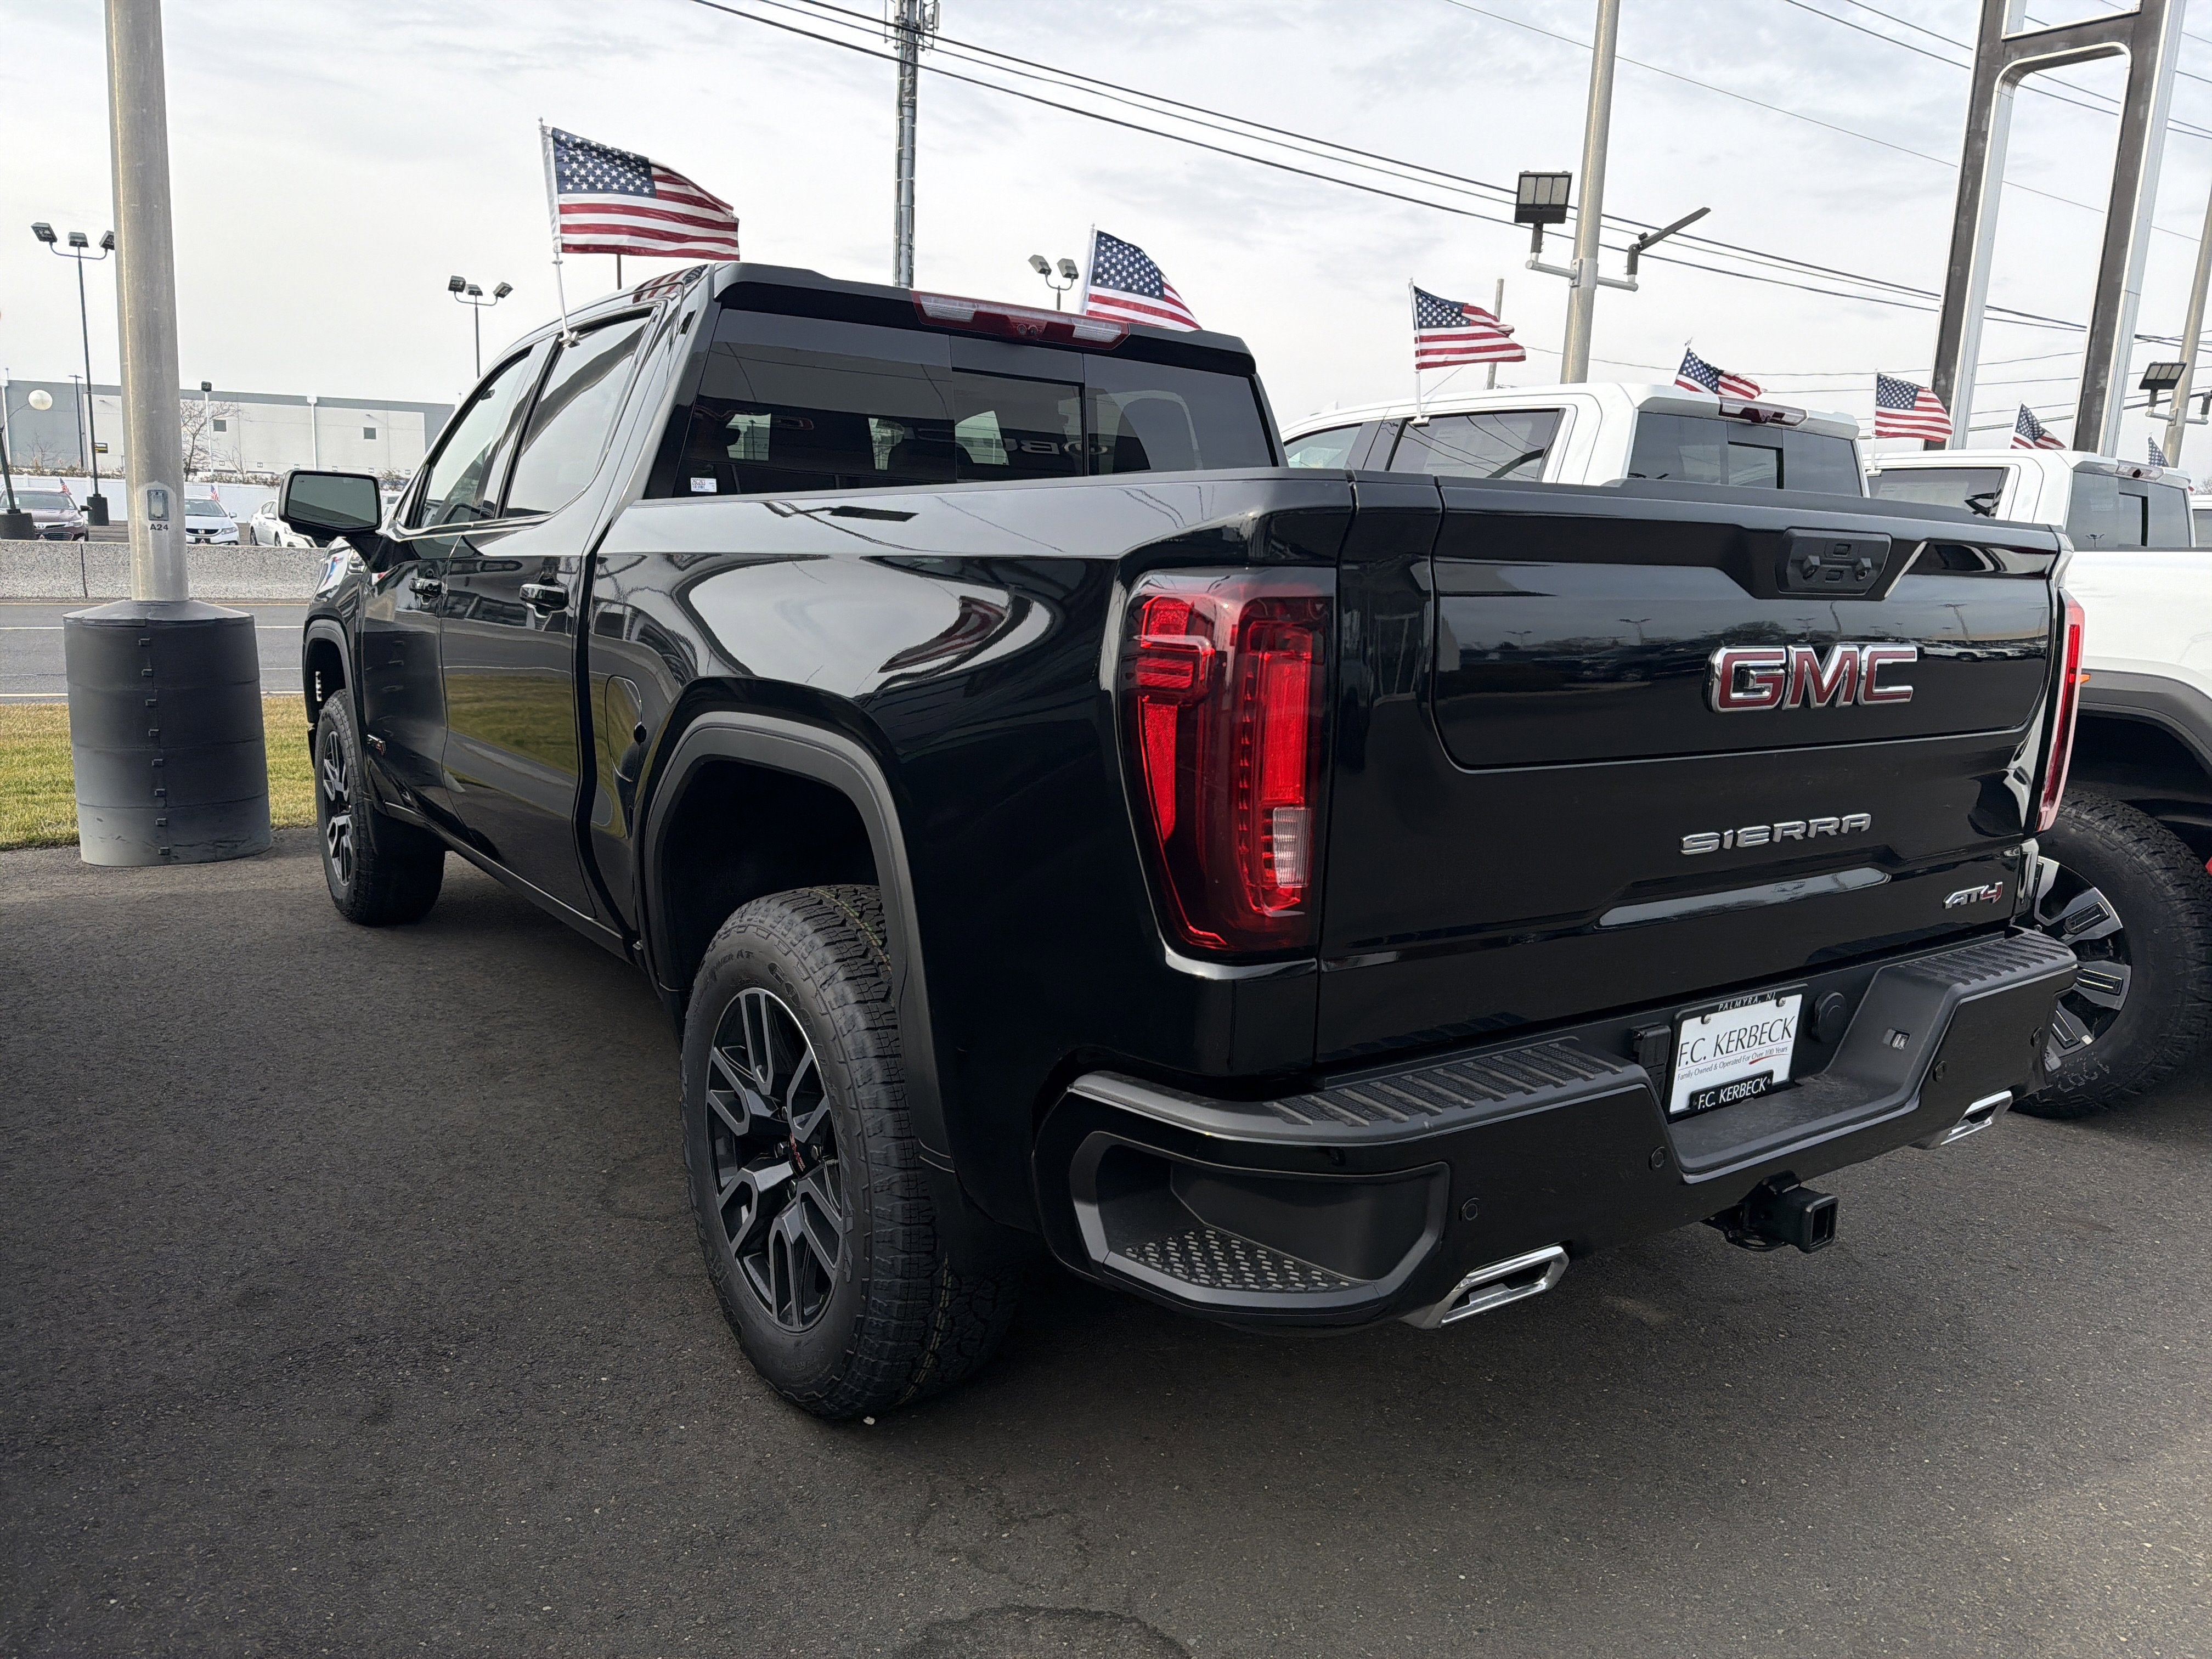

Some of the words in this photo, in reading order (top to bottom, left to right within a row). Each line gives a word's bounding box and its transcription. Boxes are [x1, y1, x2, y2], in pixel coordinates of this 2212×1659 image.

[1707, 644, 1918, 713] GMC
[1680, 812, 1872, 855] SIERRA
[1943, 881, 2003, 910] AT4
[1718, 996, 1761, 1012] PALMYRA,
[1678, 1037, 1706, 1068] F.C.
[1713, 1015, 1796, 1058] KERBECK
[1677, 1070, 1694, 1081] Family
[1694, 1063, 1713, 1076] Owned
[1719, 1057, 1742, 1069] Operated
[1751, 1051, 1764, 1060] Over
[1765, 1048, 1774, 1056] 100
[1697, 1091, 1716, 1110] F.C.
[1719, 1076, 1768, 1104] KERBECK
